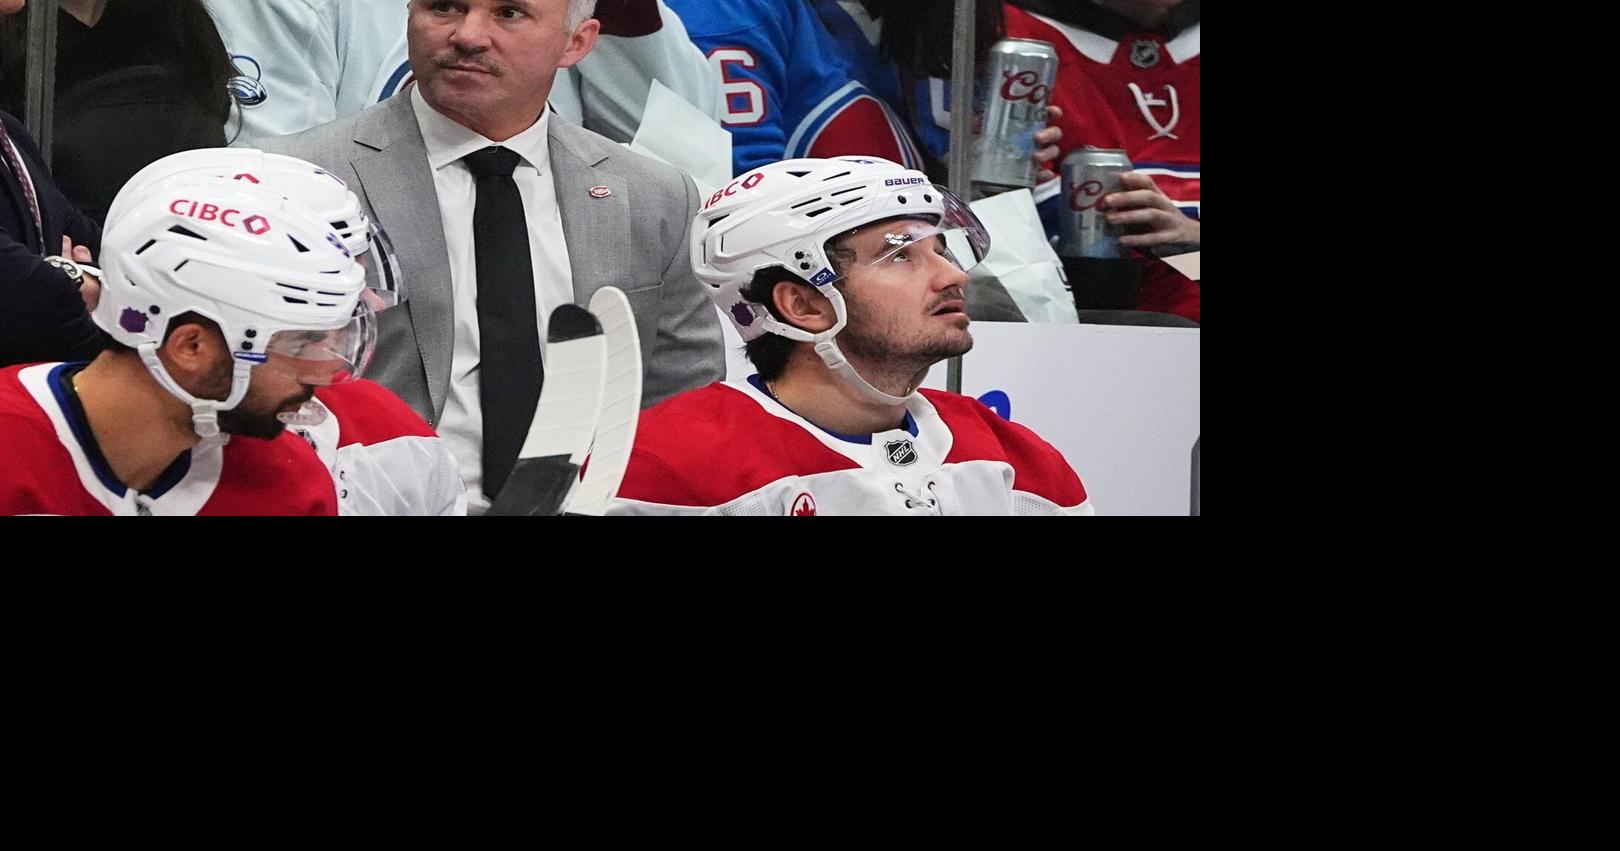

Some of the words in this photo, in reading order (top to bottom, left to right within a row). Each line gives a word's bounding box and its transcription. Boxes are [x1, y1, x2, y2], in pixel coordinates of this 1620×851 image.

[706, 47, 767, 127] 6
[1000, 70, 1050, 104] Co
[1010, 101, 1048, 121] LIG
[702, 180, 740, 210] IBC
[169, 199, 241, 228] CIBC
[892, 445, 910, 462] NHL
